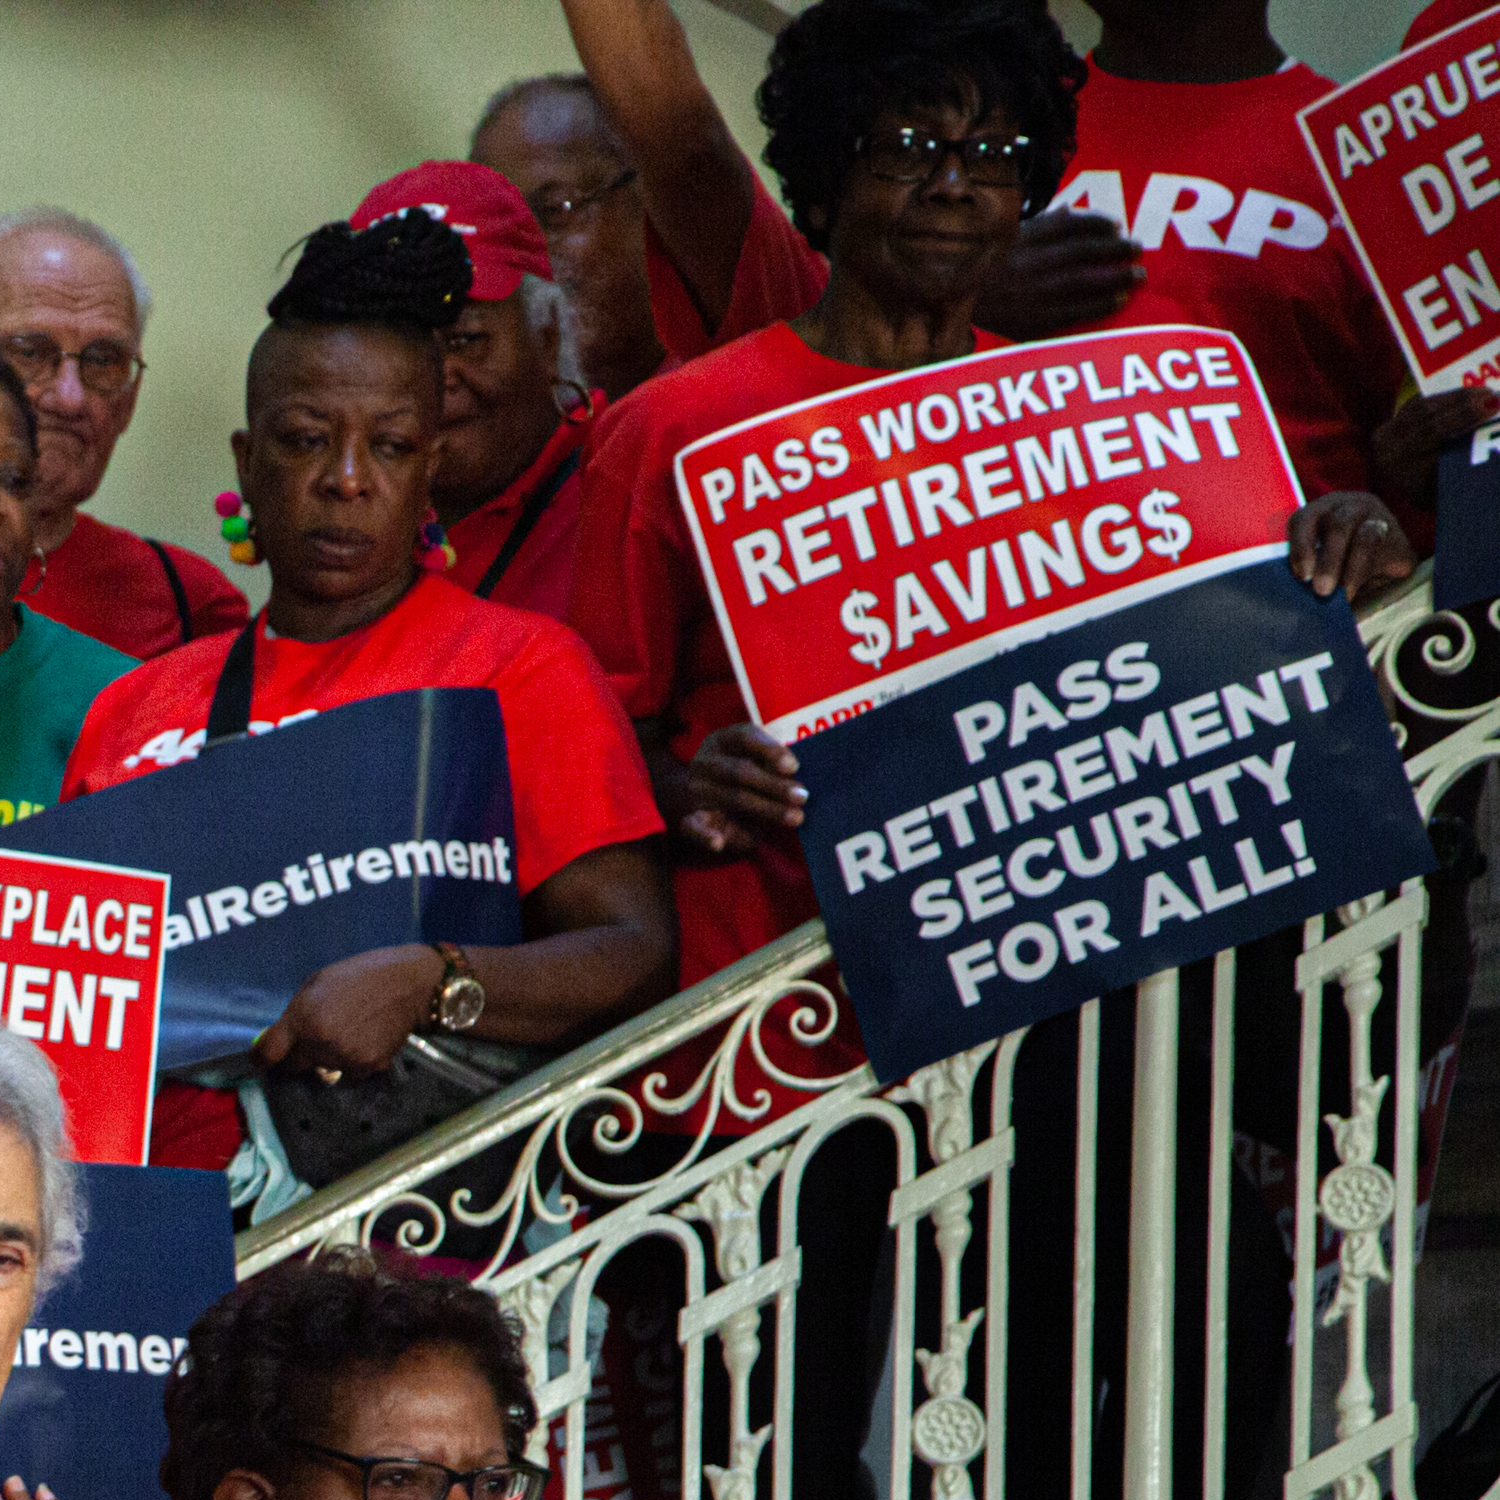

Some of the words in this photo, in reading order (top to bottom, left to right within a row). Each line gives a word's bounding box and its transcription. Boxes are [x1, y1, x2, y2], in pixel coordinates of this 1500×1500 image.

[1402, 133, 1500, 236] DE
[700, 426, 850, 524] PASS
[860, 346, 1240, 462] WORKPLACE
[732, 402, 1242, 606] RETIREMENT
[839, 488, 1192, 669] $AVING$
[834, 653, 1334, 894] RETIREMENT
[953, 642, 1161, 764] PASS
[164, 837, 512, 949] alRetirement
[909, 743, 1297, 940] SECURITY
[946, 899, 1119, 1007] FOR
[1140, 820, 1317, 937] ALL!
